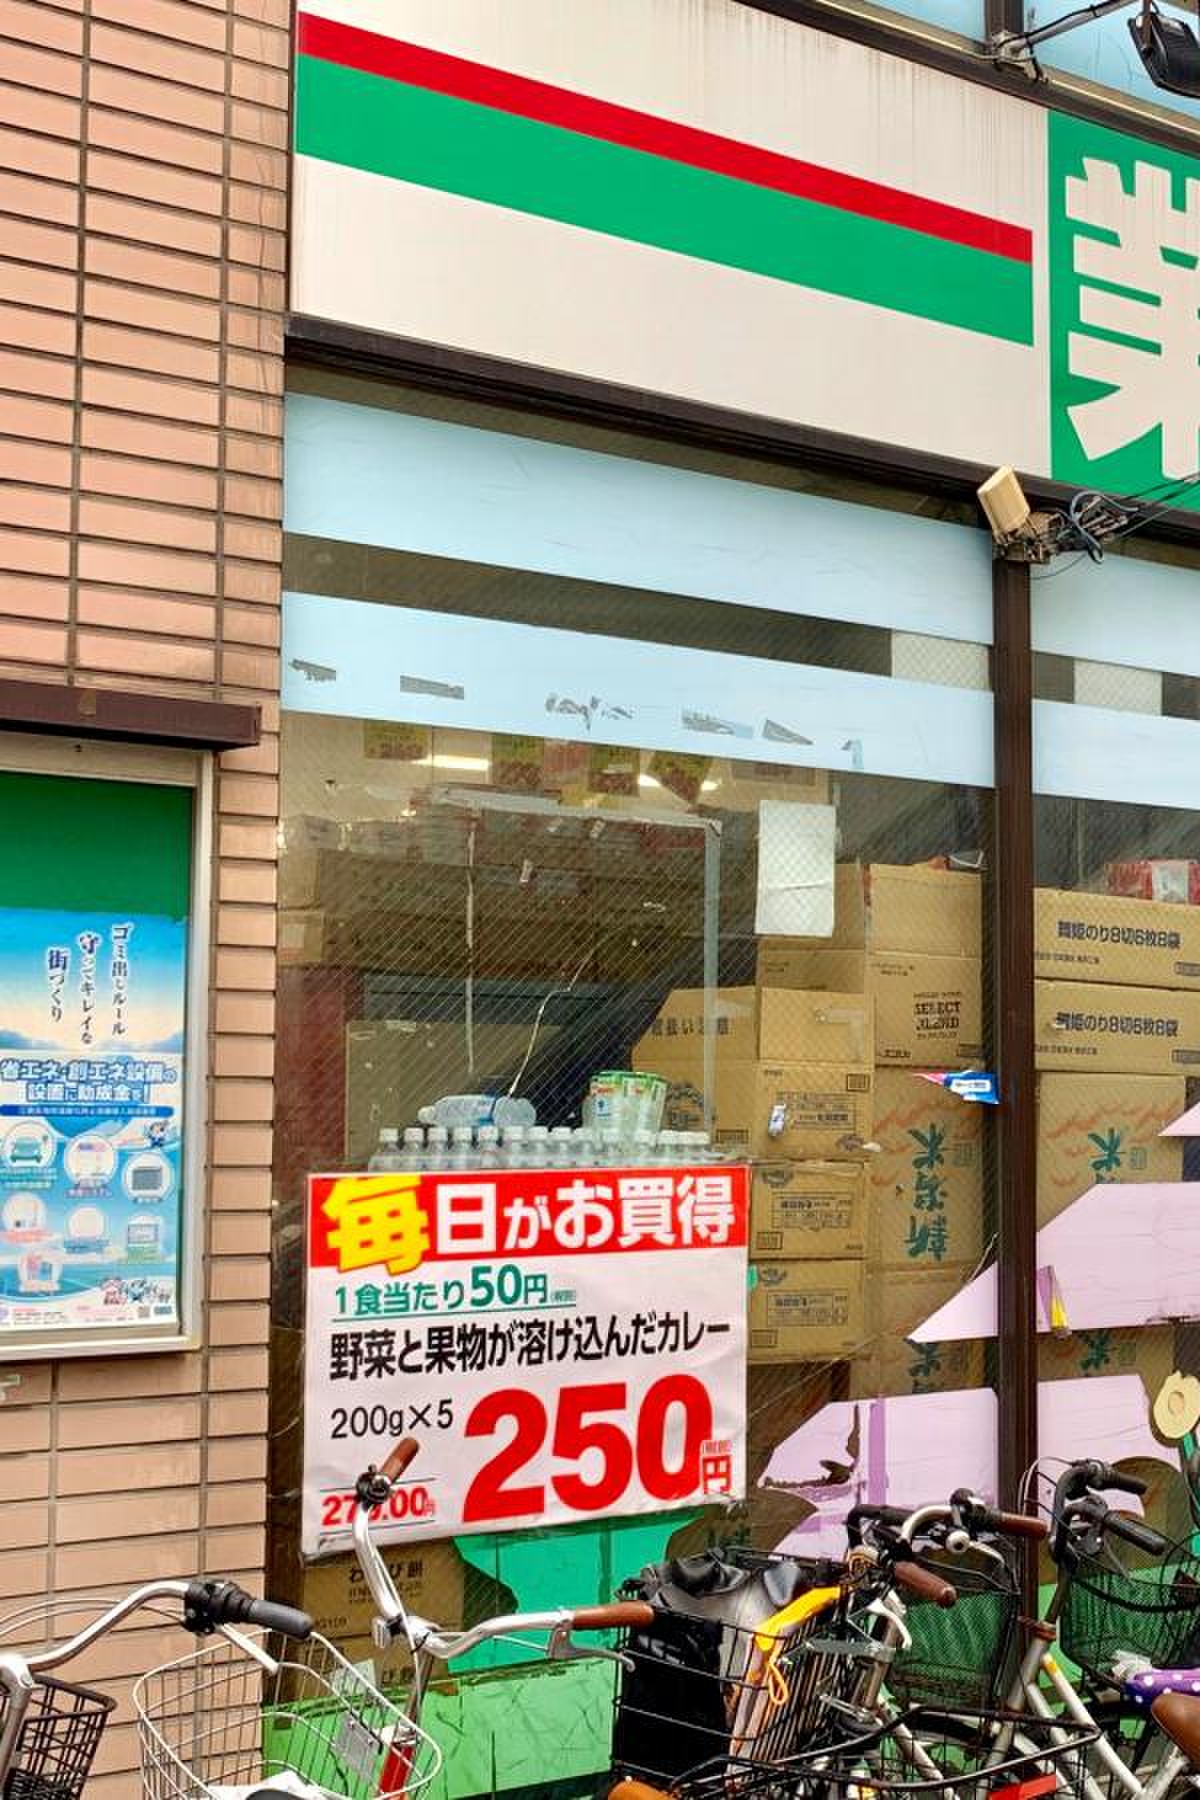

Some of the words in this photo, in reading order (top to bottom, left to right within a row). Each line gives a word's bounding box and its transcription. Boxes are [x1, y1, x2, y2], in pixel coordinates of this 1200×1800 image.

[321, 1174, 736, 1277] 毎日がお買得
[335, 1263, 548, 1314] 1食当たり50円
[329, 1311, 730, 1381] 野菜と果物が溶け込んだカレー
